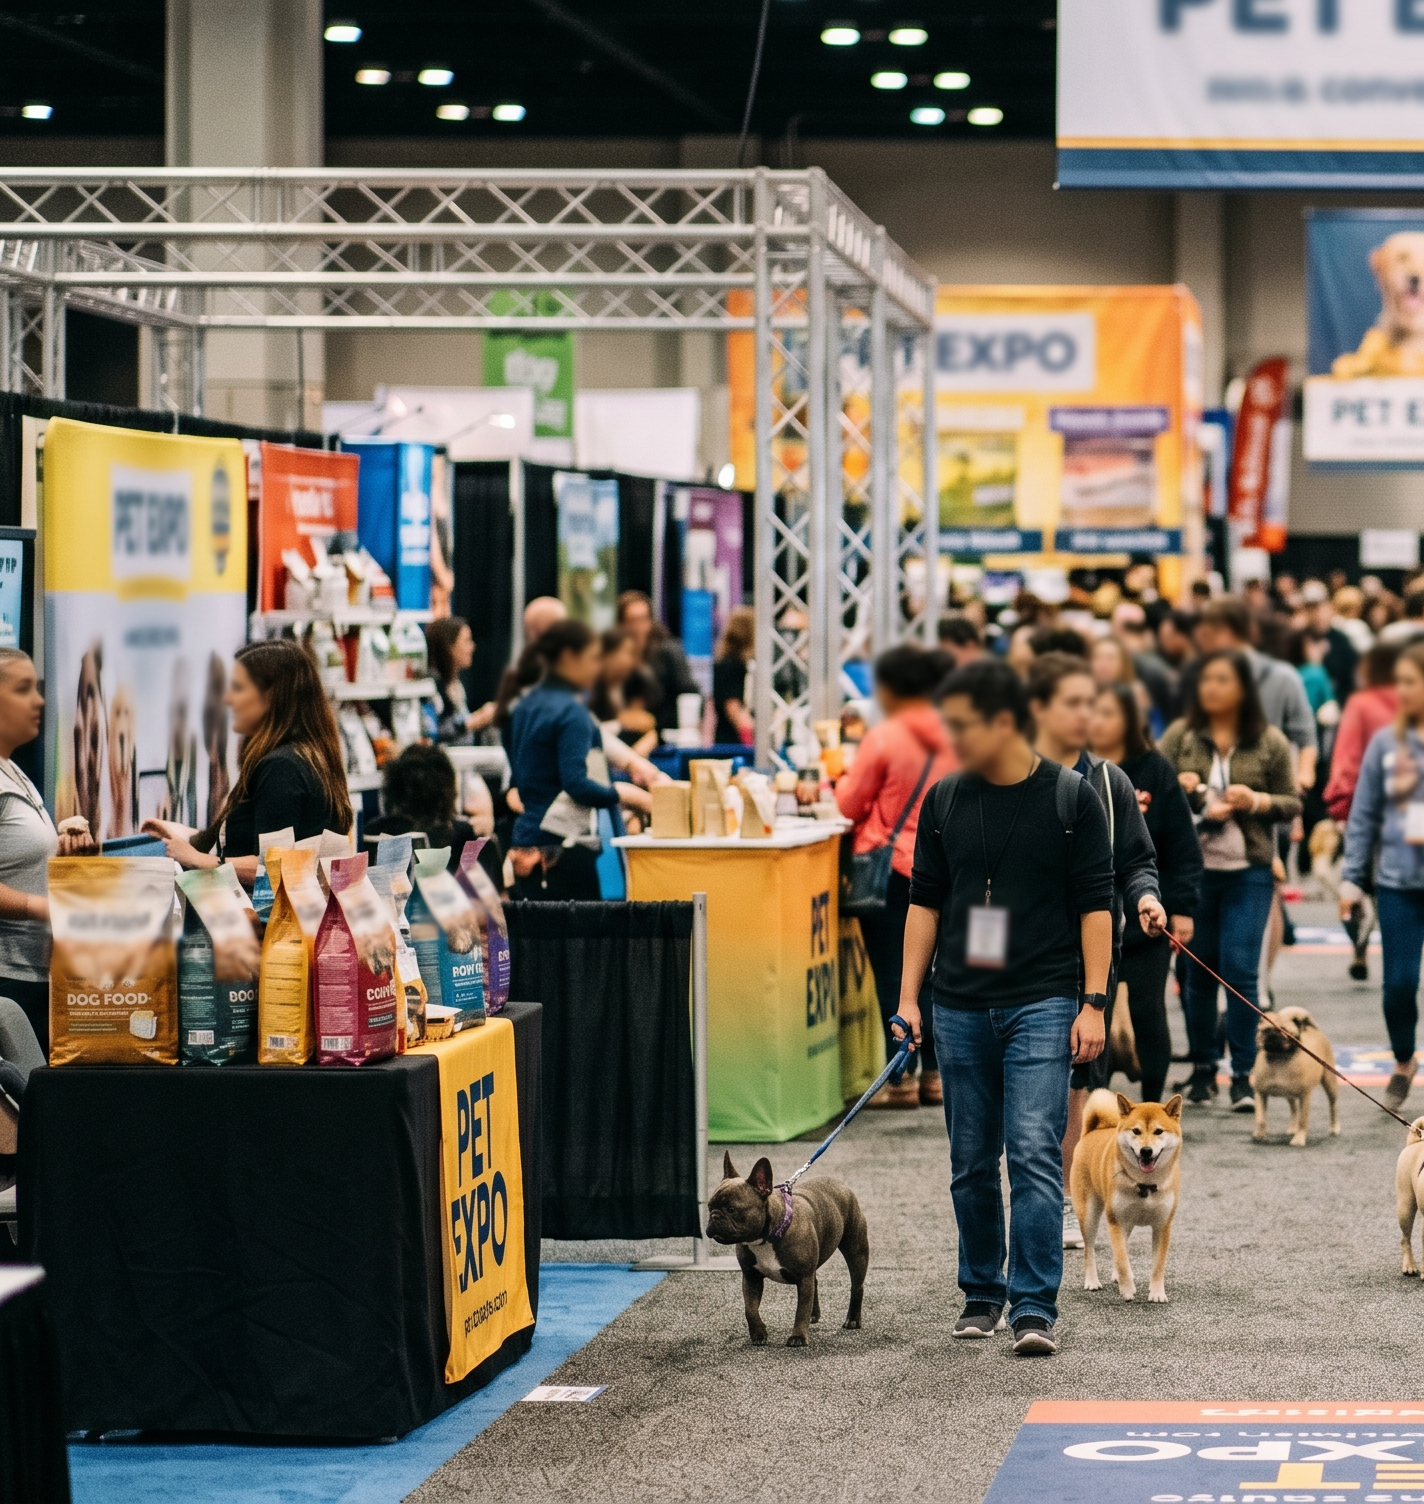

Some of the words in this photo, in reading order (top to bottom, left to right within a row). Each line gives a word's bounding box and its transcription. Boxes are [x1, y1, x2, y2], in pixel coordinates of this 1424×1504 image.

[936, 331, 1079, 374] EXPO
[1333, 398, 1392, 427] PET
[67, 993, 100, 1006] DOG
[104, 992, 148, 1005] FOOD
[457, 1071, 495, 1189] PET
[451, 1170, 508, 1294] EXPO
